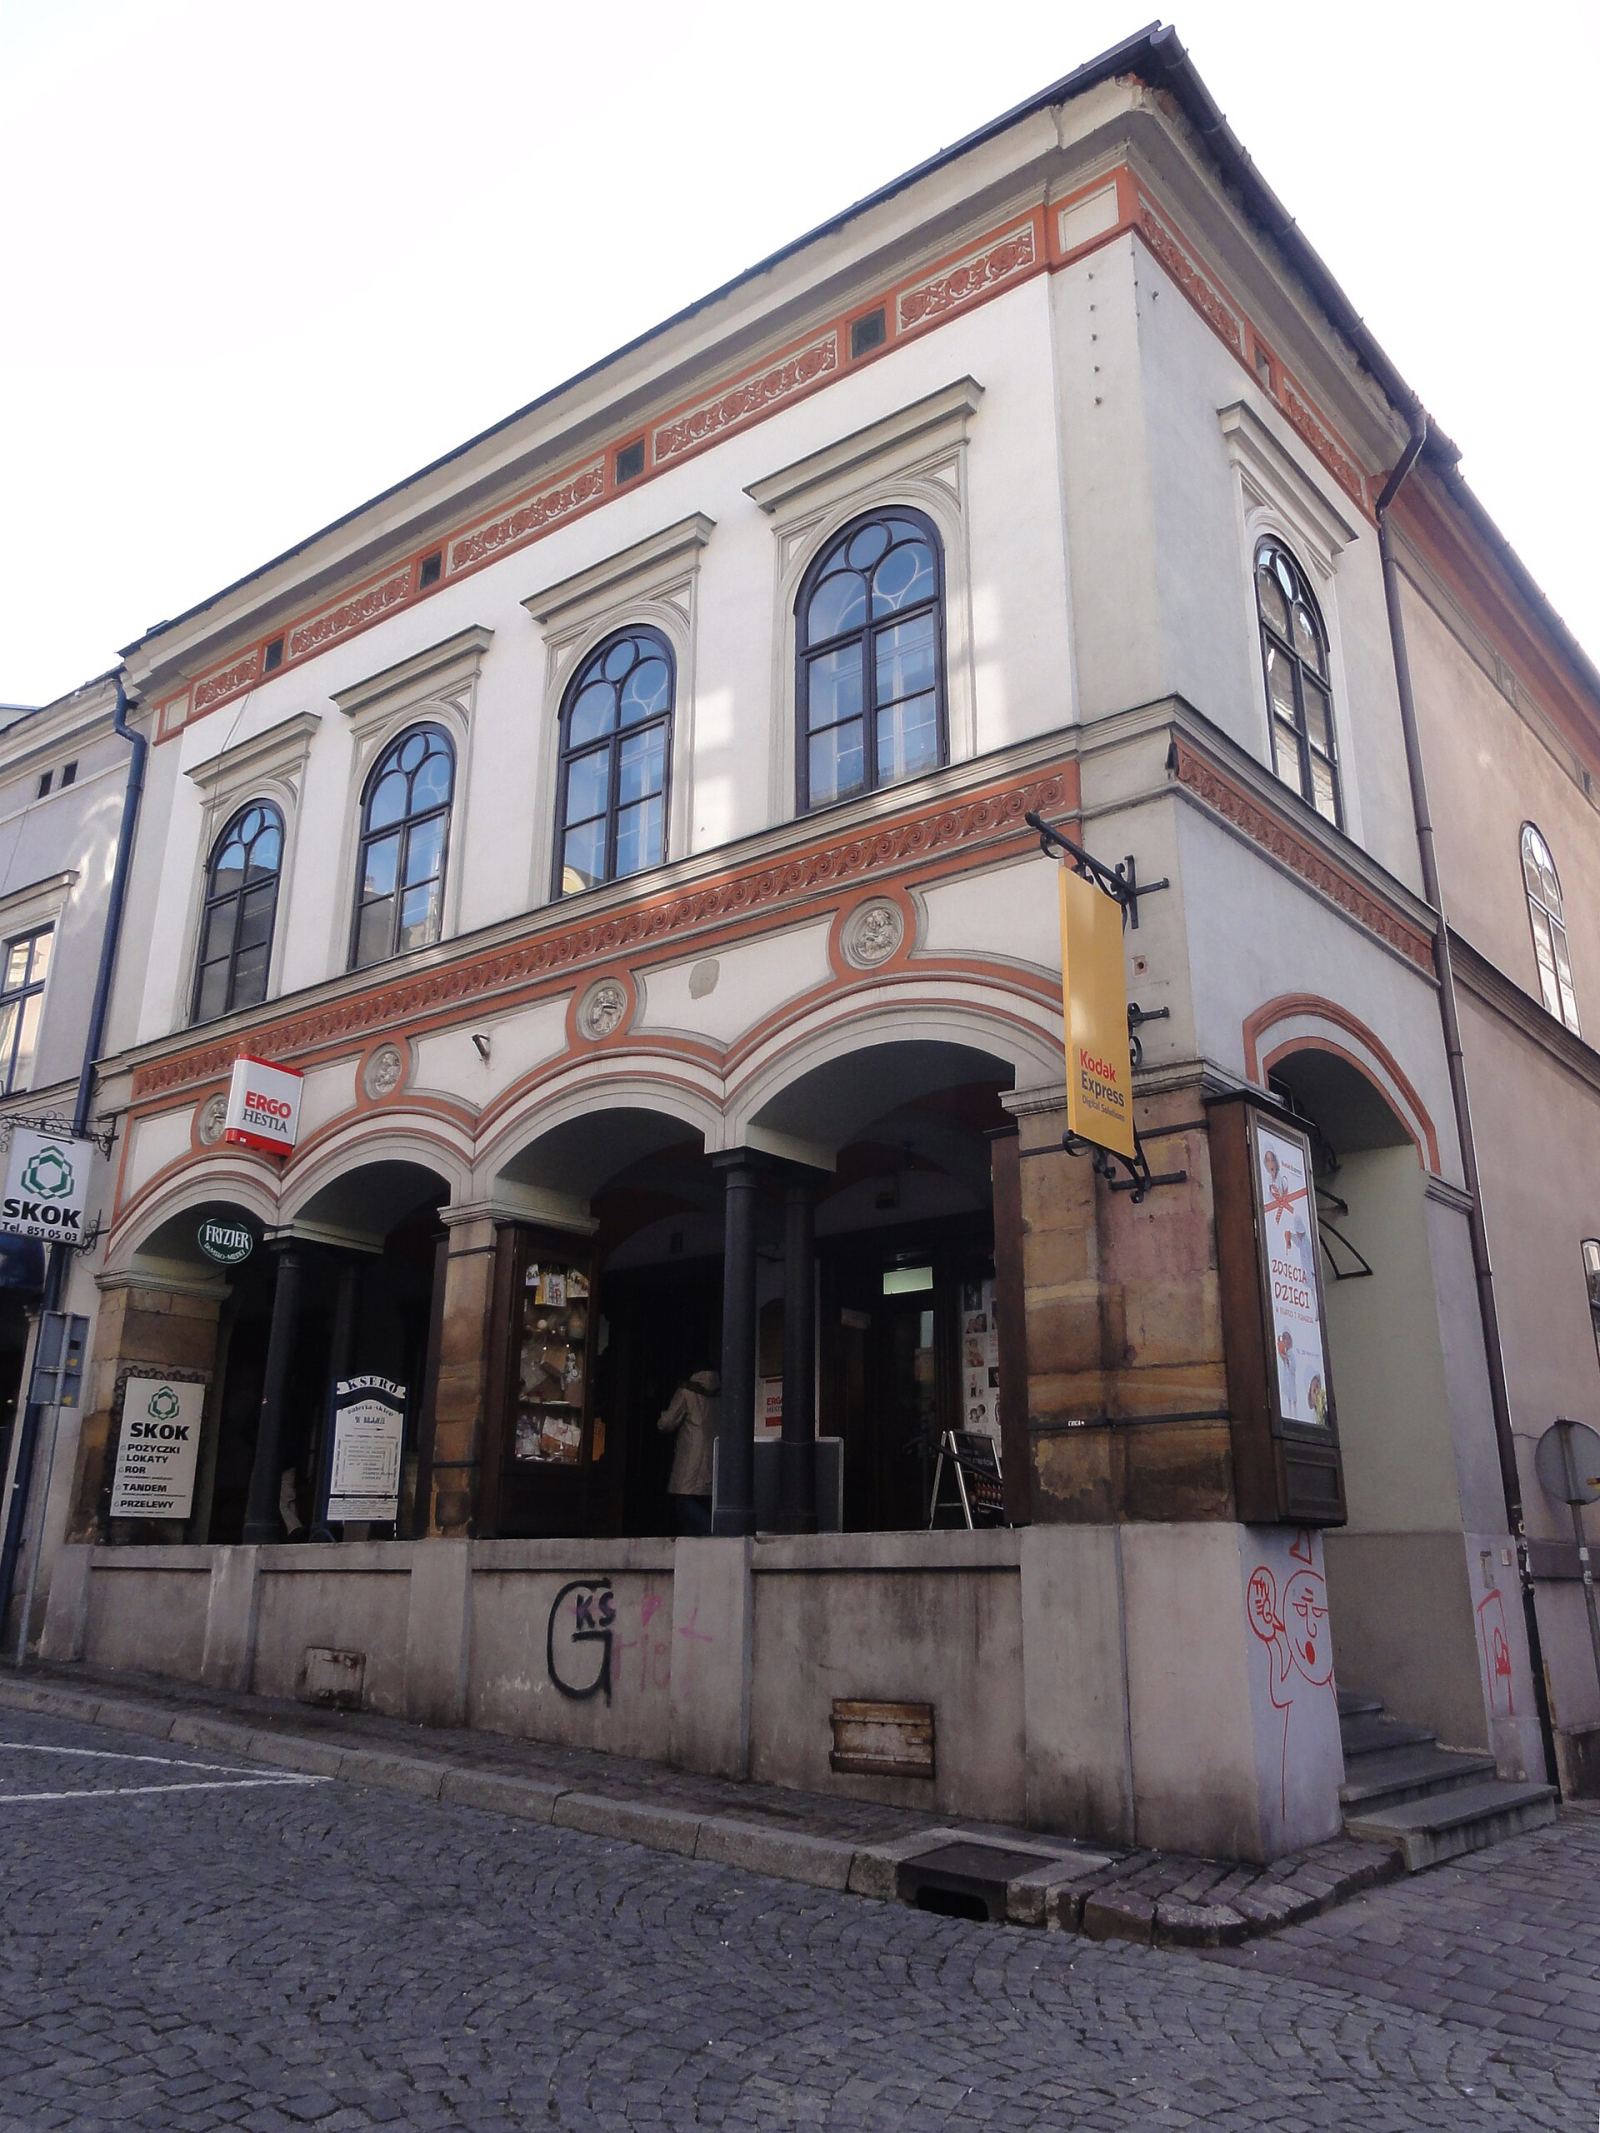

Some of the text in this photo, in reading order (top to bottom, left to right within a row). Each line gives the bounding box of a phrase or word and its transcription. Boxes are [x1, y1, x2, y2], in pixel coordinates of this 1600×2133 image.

[1080, 1048, 1116, 1083] Kodak
[1081, 1070, 1125, 1107] Express
[245, 1090, 292, 1119] ERGO
[242, 1108, 288, 1134] HESTIA
[2, 1198, 81, 1229] SKOK
[2, 1221, 77, 1242] Tel. 851 05 03
[205, 1224, 249, 1250] FRYZJER
[1271, 1259, 1308, 1284] ZDJĘCIA
[1274, 1281, 1310, 1309] DZIECI
[347, 1376, 398, 1394] KSERO
[766, 1396, 783, 1406] ERG
[130, 1422, 190, 1441] SKOK
[124, 1465, 146, 1474] ROR
[126, 1454, 168, 1463] LOKATY
[122, 1483, 167, 1492] TANDEM
[120, 1500, 174, 1508] PRZELEWY
